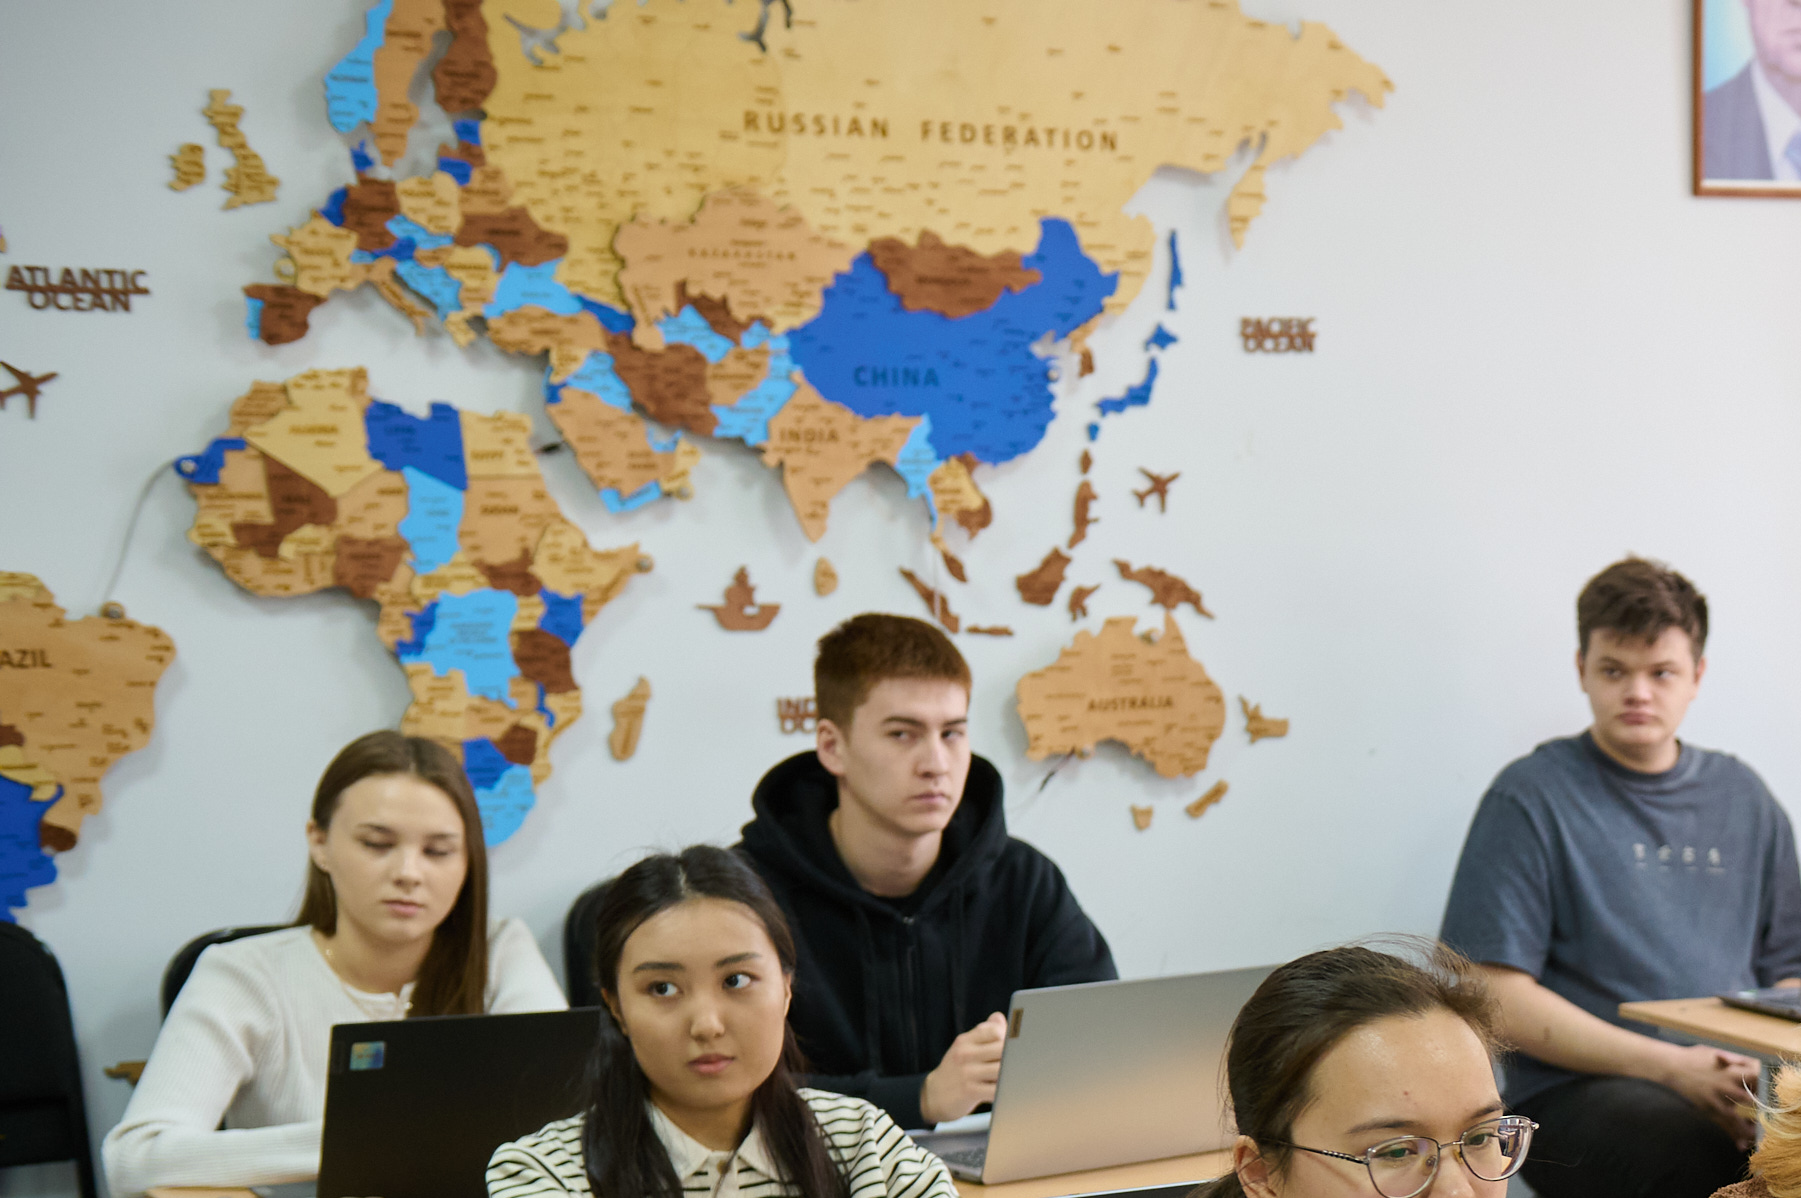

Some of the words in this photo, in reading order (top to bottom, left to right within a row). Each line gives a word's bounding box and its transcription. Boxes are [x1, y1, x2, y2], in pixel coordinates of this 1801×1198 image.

[743, 109, 890, 139] RUSSIAN
[920, 119, 1118, 151] FEDERATION
[6, 264, 150, 294] ATLANTIC
[27, 290, 131, 312] OCEAN
[853, 365, 939, 387] CHINA
[779, 426, 840, 444] INDIA
[1086, 694, 1174, 712] AUSTRALIA
